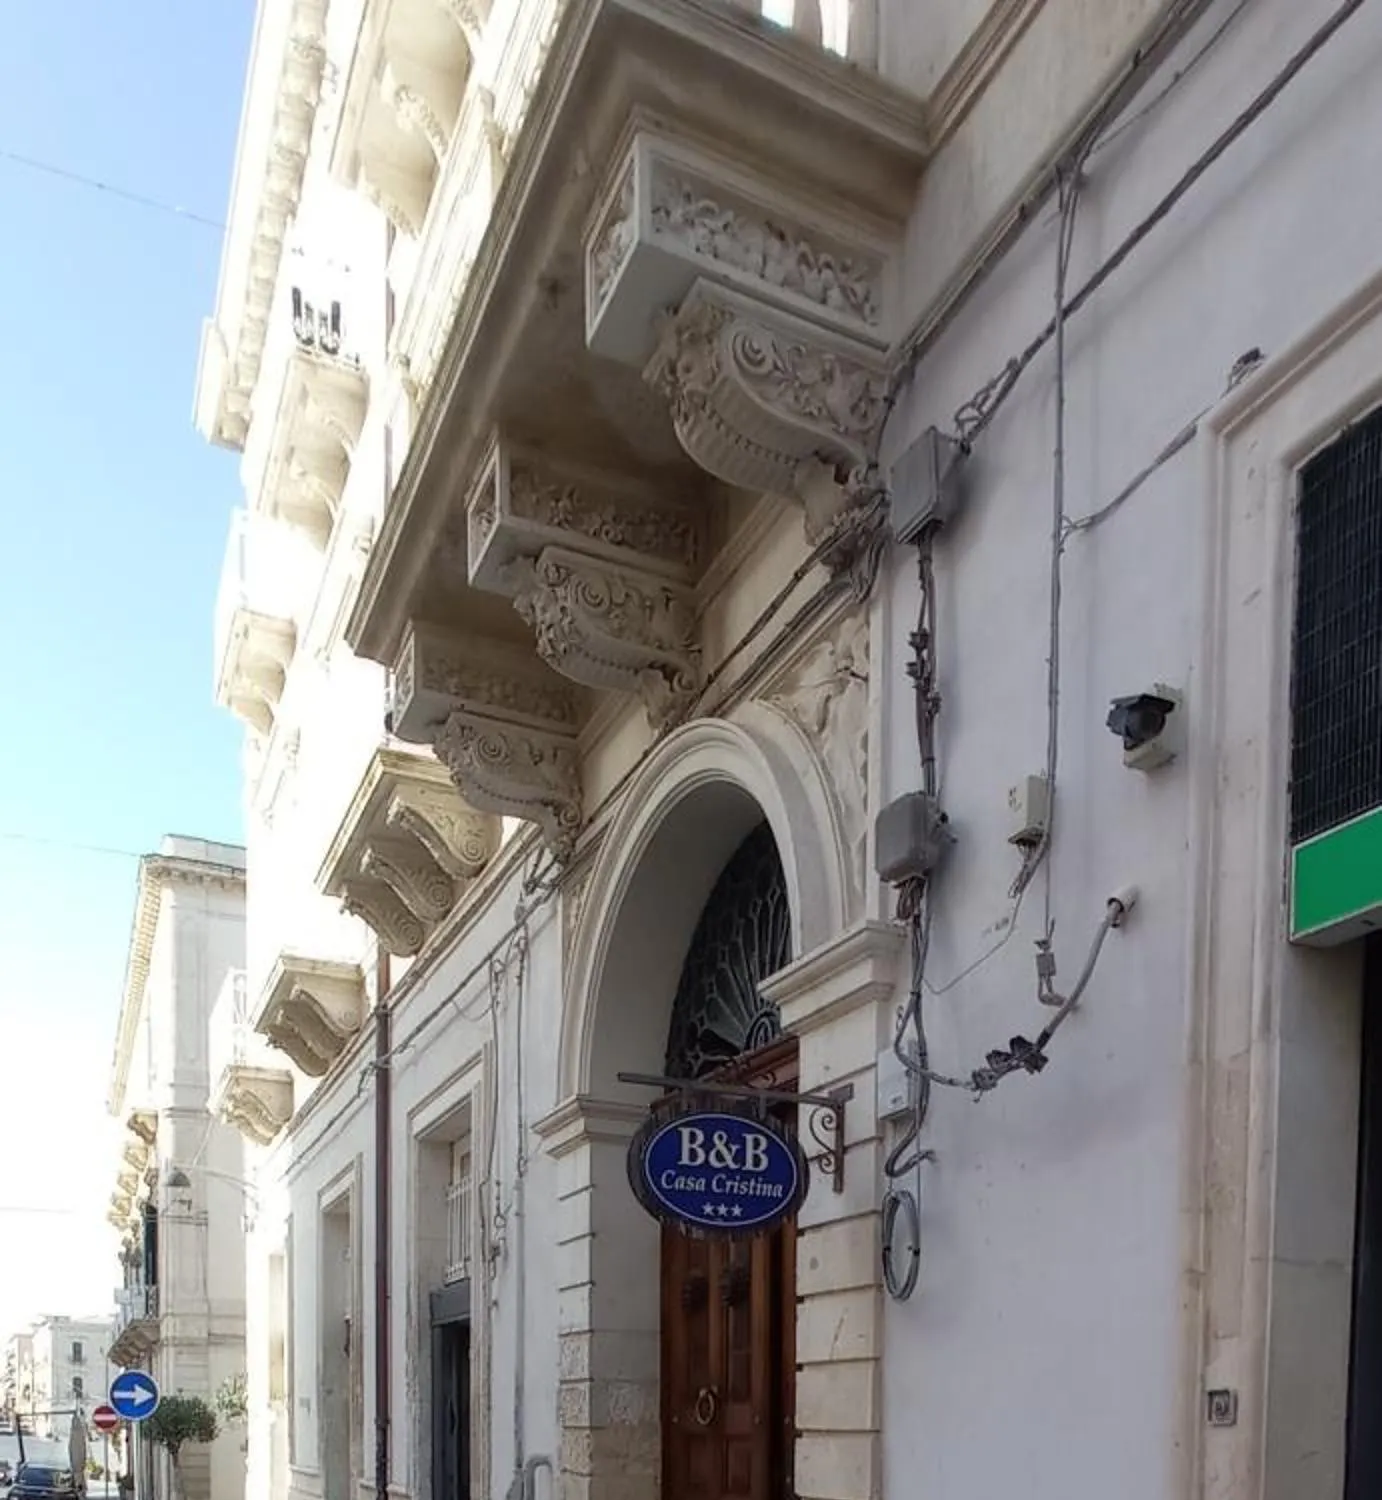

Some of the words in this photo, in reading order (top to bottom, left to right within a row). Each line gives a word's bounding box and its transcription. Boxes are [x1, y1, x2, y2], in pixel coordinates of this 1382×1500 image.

[677, 1127, 769, 1172] B&B
[662, 1169, 705, 1191] Casa
[711, 1173, 783, 1198] Cristina
